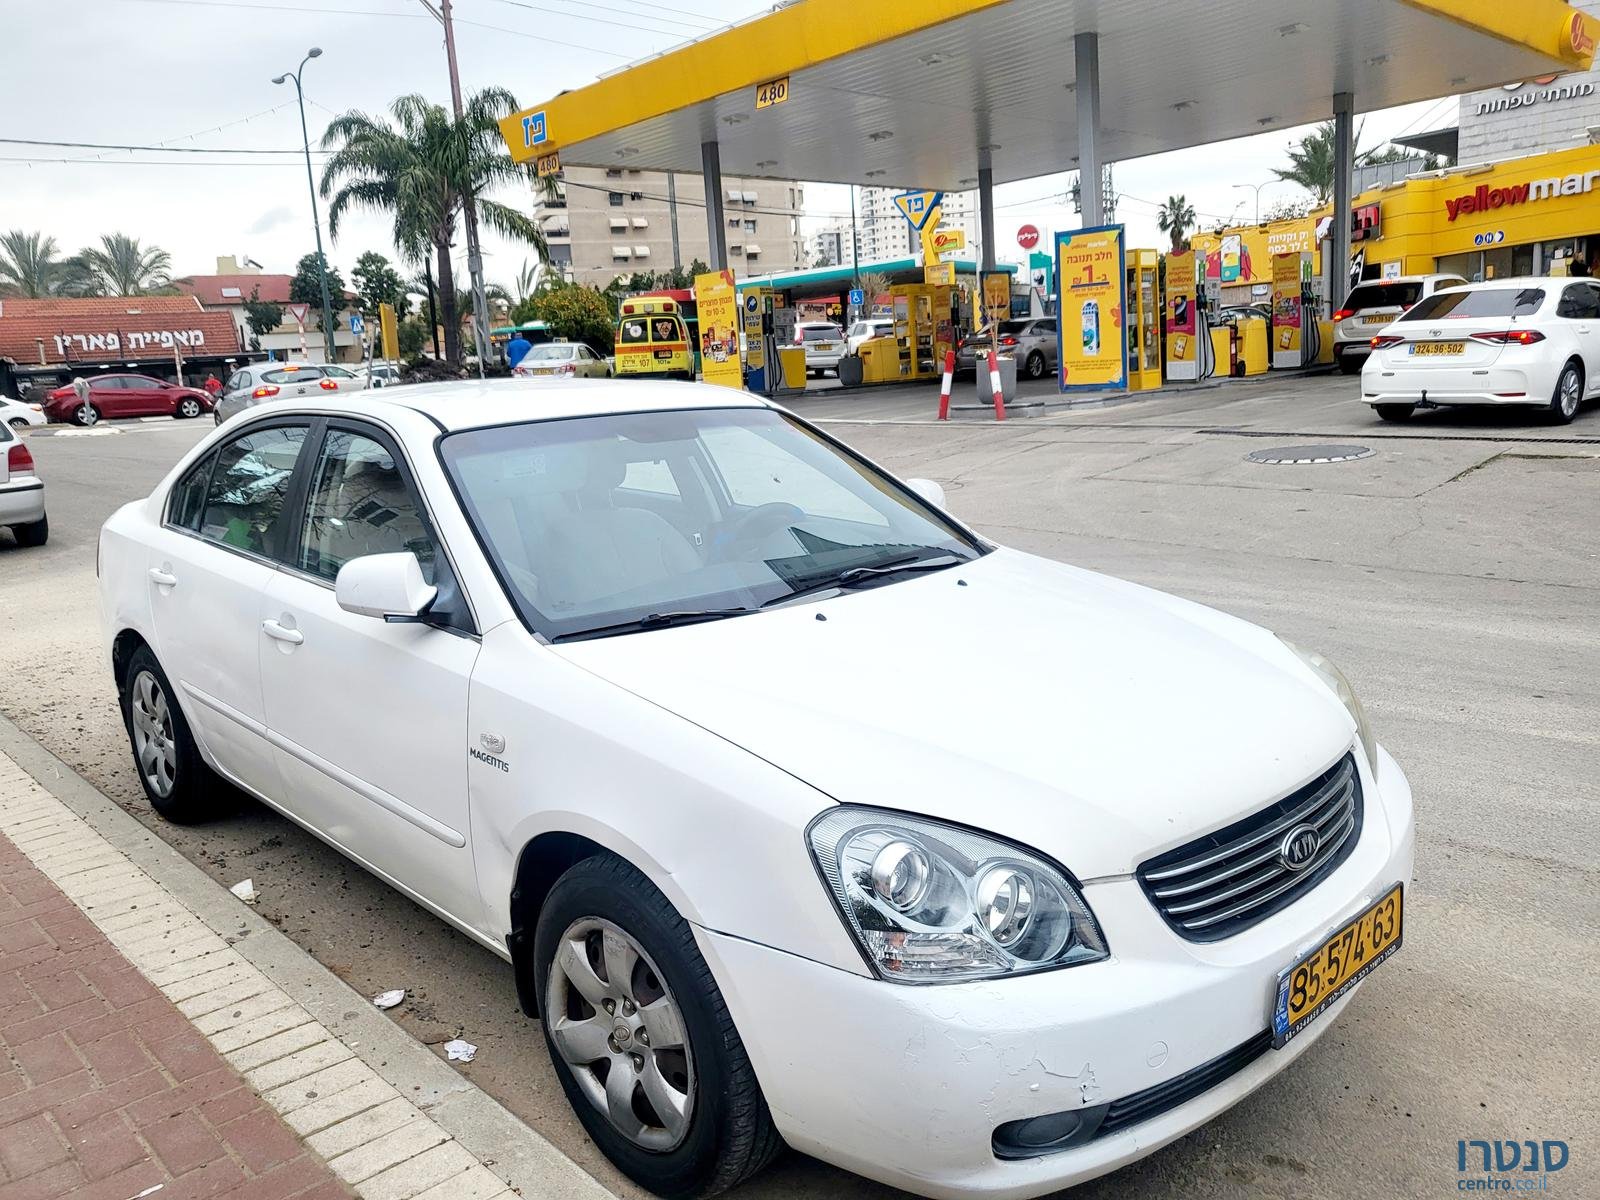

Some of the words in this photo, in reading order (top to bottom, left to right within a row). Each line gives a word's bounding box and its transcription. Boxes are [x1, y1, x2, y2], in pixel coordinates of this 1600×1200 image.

[1542, 82, 1595, 101] מזרחי
[1476, 92, 1536, 116] טפחות
[522, 111, 547, 148] פז
[907, 197, 924, 213] פז
[1066, 254, 1093, 265] תנובה
[1095, 251, 1113, 262] חלב
[53, 332, 120, 355] פארין
[127, 329, 204, 349] מאפיית
[639, 359, 650, 368] 107
[470, 747, 509, 773] MAGENTIS
[1291, 833, 1316, 862] KIA
